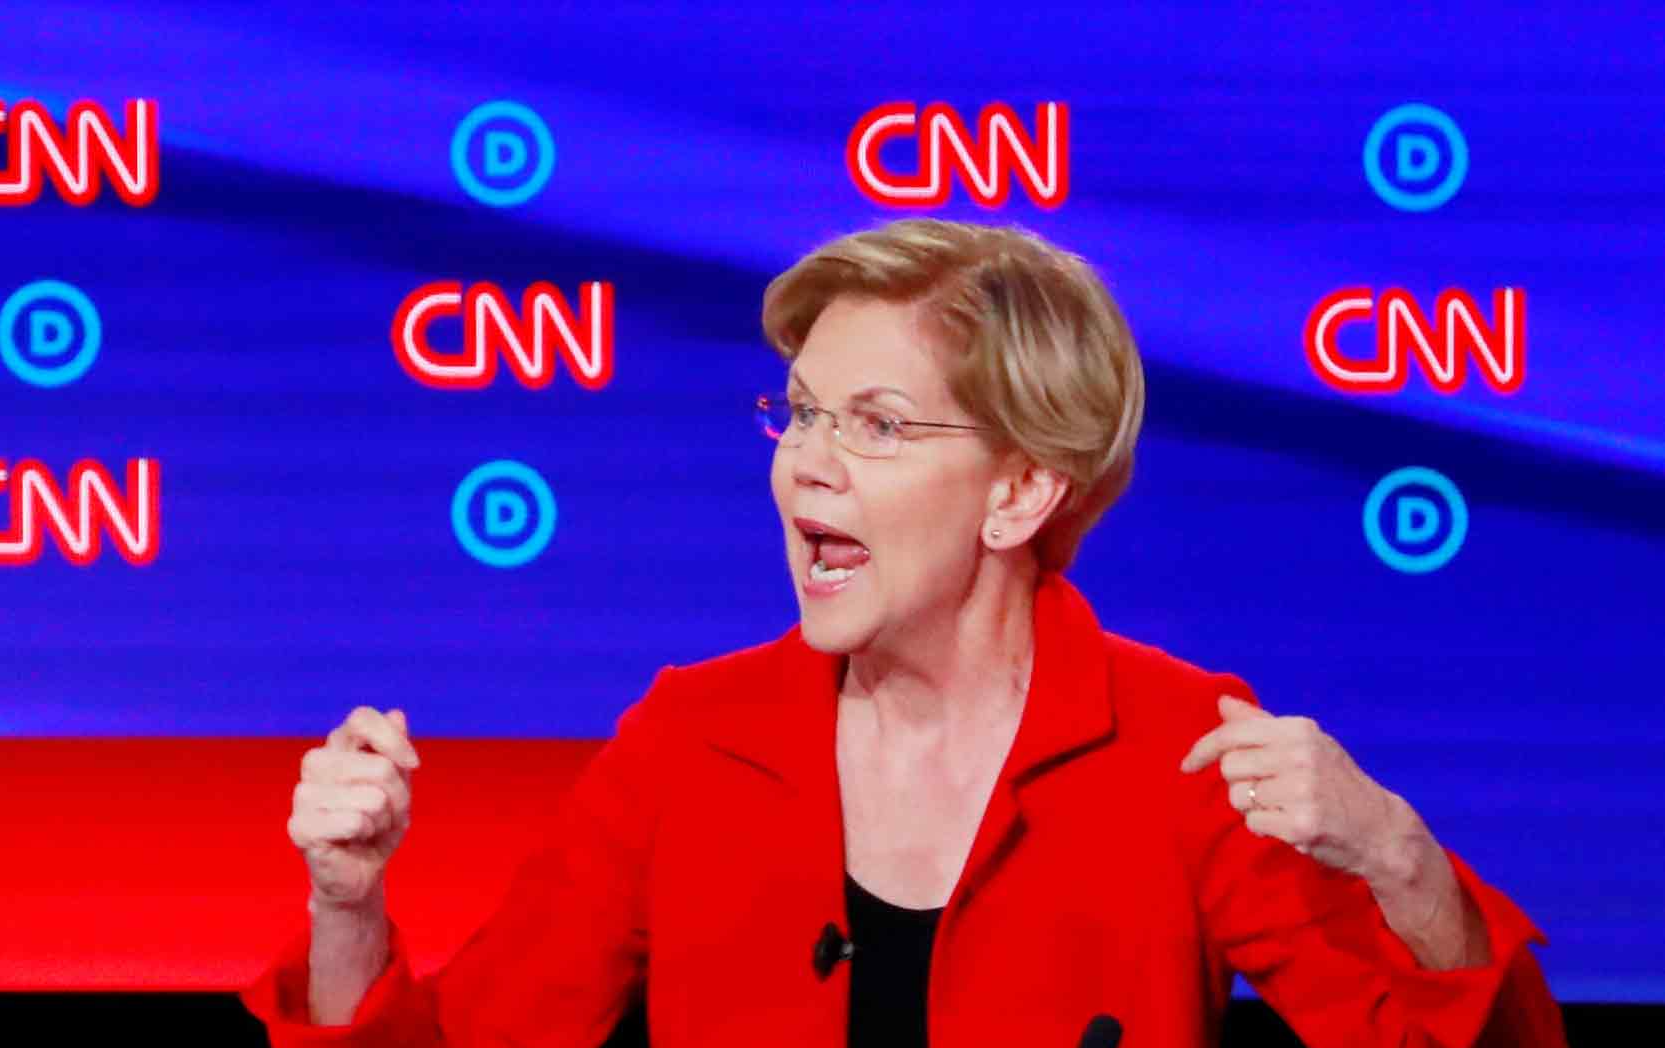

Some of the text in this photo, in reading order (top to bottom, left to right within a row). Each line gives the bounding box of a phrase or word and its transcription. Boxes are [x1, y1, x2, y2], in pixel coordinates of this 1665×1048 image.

[484, 131, 528, 178] D
[846, 101, 1071, 208] CNN
[1396, 135, 1441, 181] D
[29, 309, 73, 357] D
[391, 282, 613, 389] CNN
[1303, 287, 1526, 395] CNN
[484, 490, 529, 537] D
[1396, 496, 1441, 542] D
